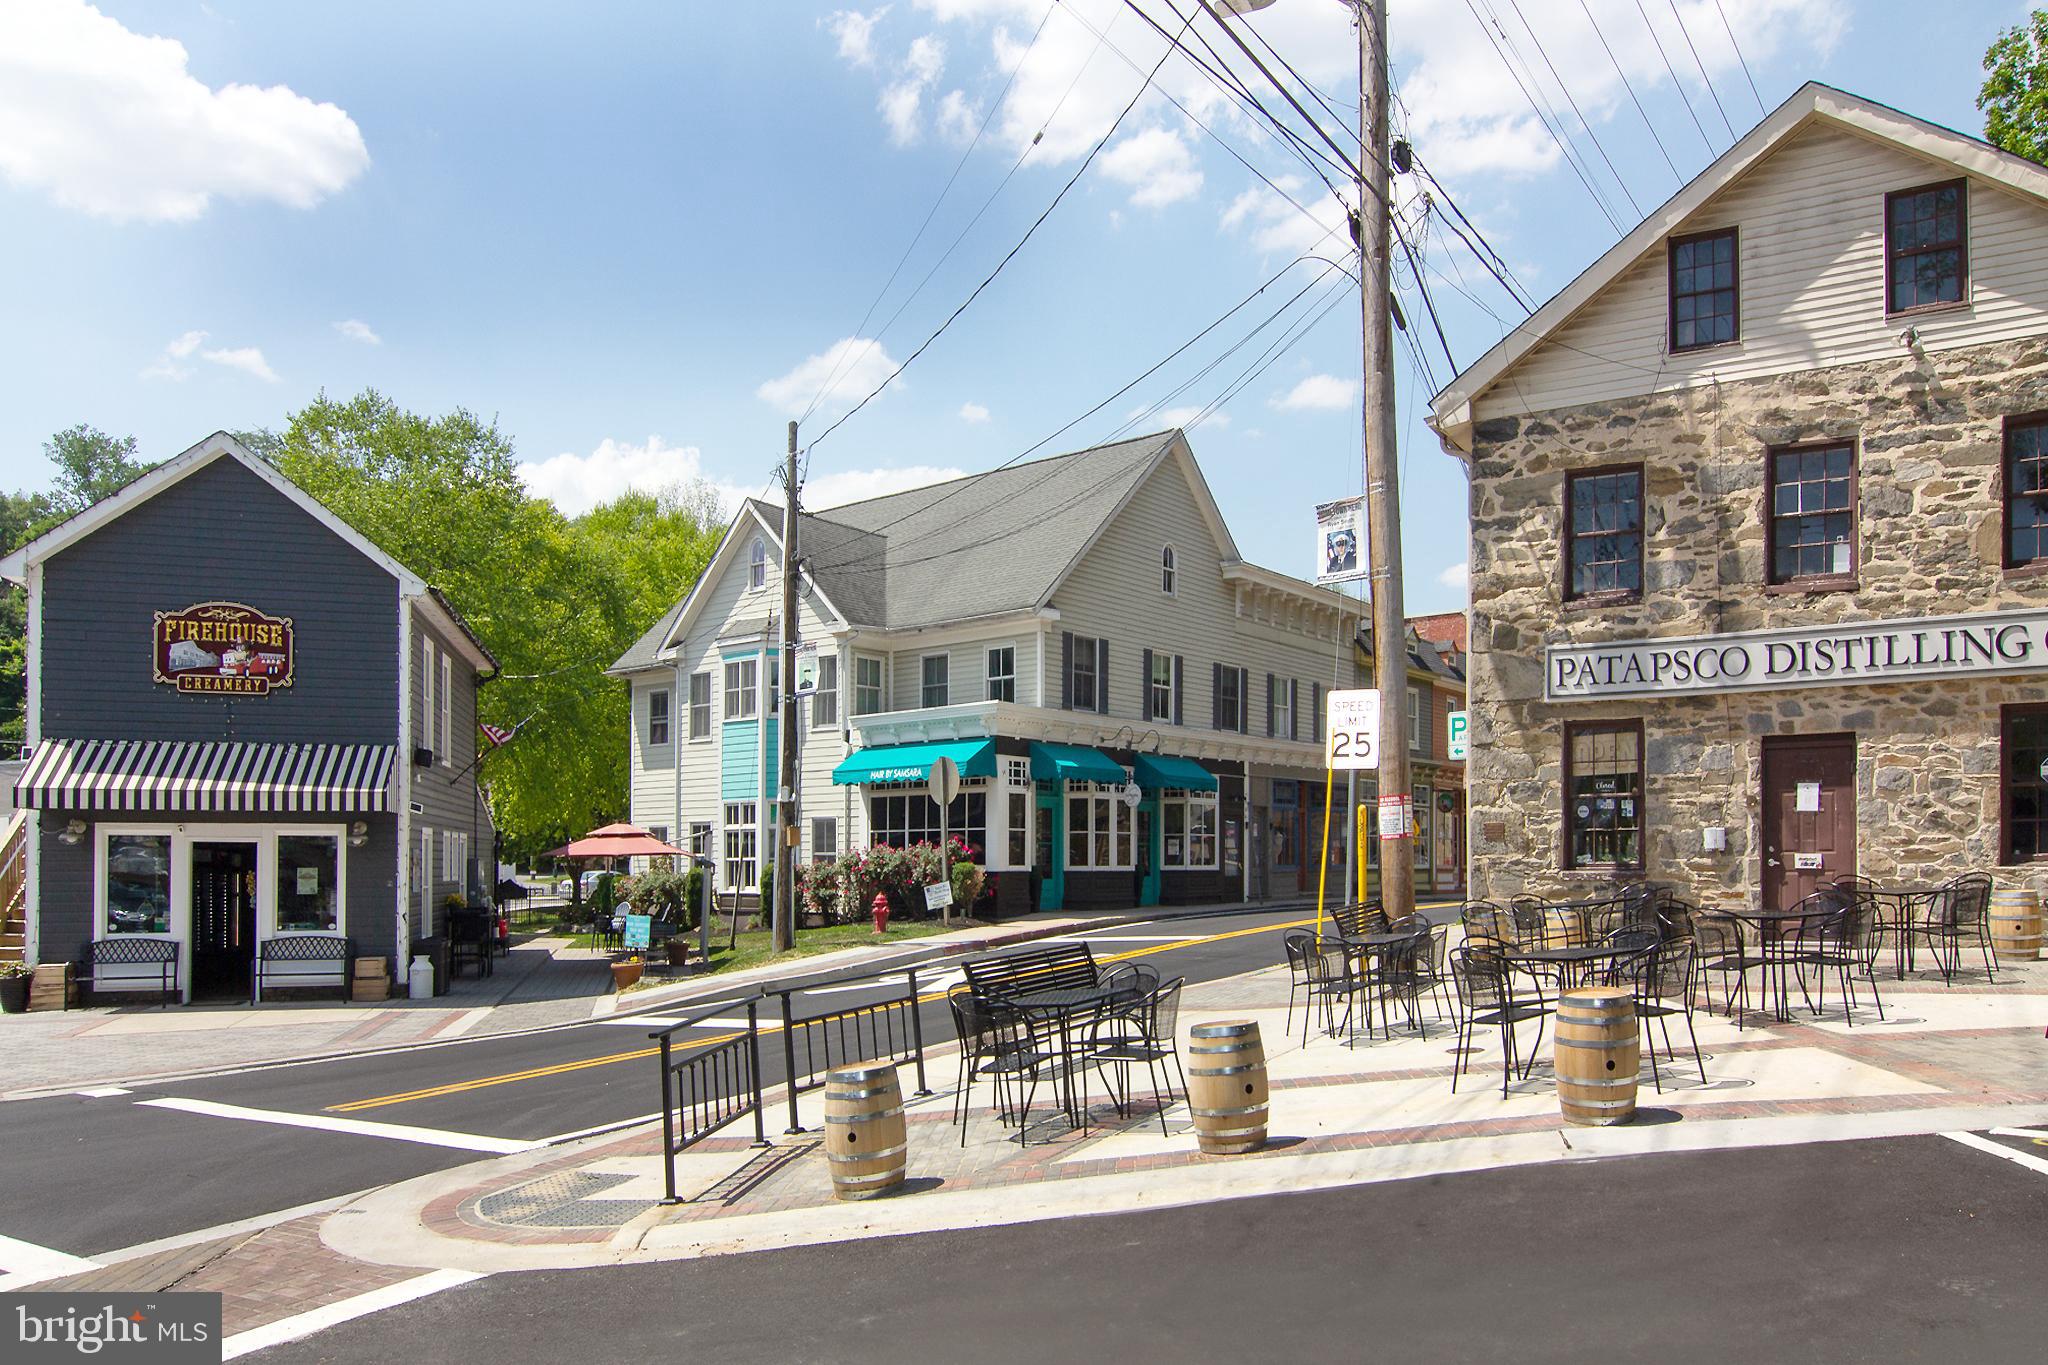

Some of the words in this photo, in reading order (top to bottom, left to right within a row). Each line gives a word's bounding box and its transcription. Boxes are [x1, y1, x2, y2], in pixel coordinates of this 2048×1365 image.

[164, 619, 284, 647] FIREHOUSE
[1555, 647, 1751, 689] PATAPSCO
[1764, 625, 2032, 677] DISTILLING
[184, 677, 262, 692] CREAMERY
[1334, 700, 1374, 712] SPEED
[1338, 716, 1367, 728] LIMIT
[1333, 732, 1371, 758] 25
[870, 770, 885, 780] HAIR
[885, 769, 894, 779] BY
[894, 767, 922, 778] SAMSARA
